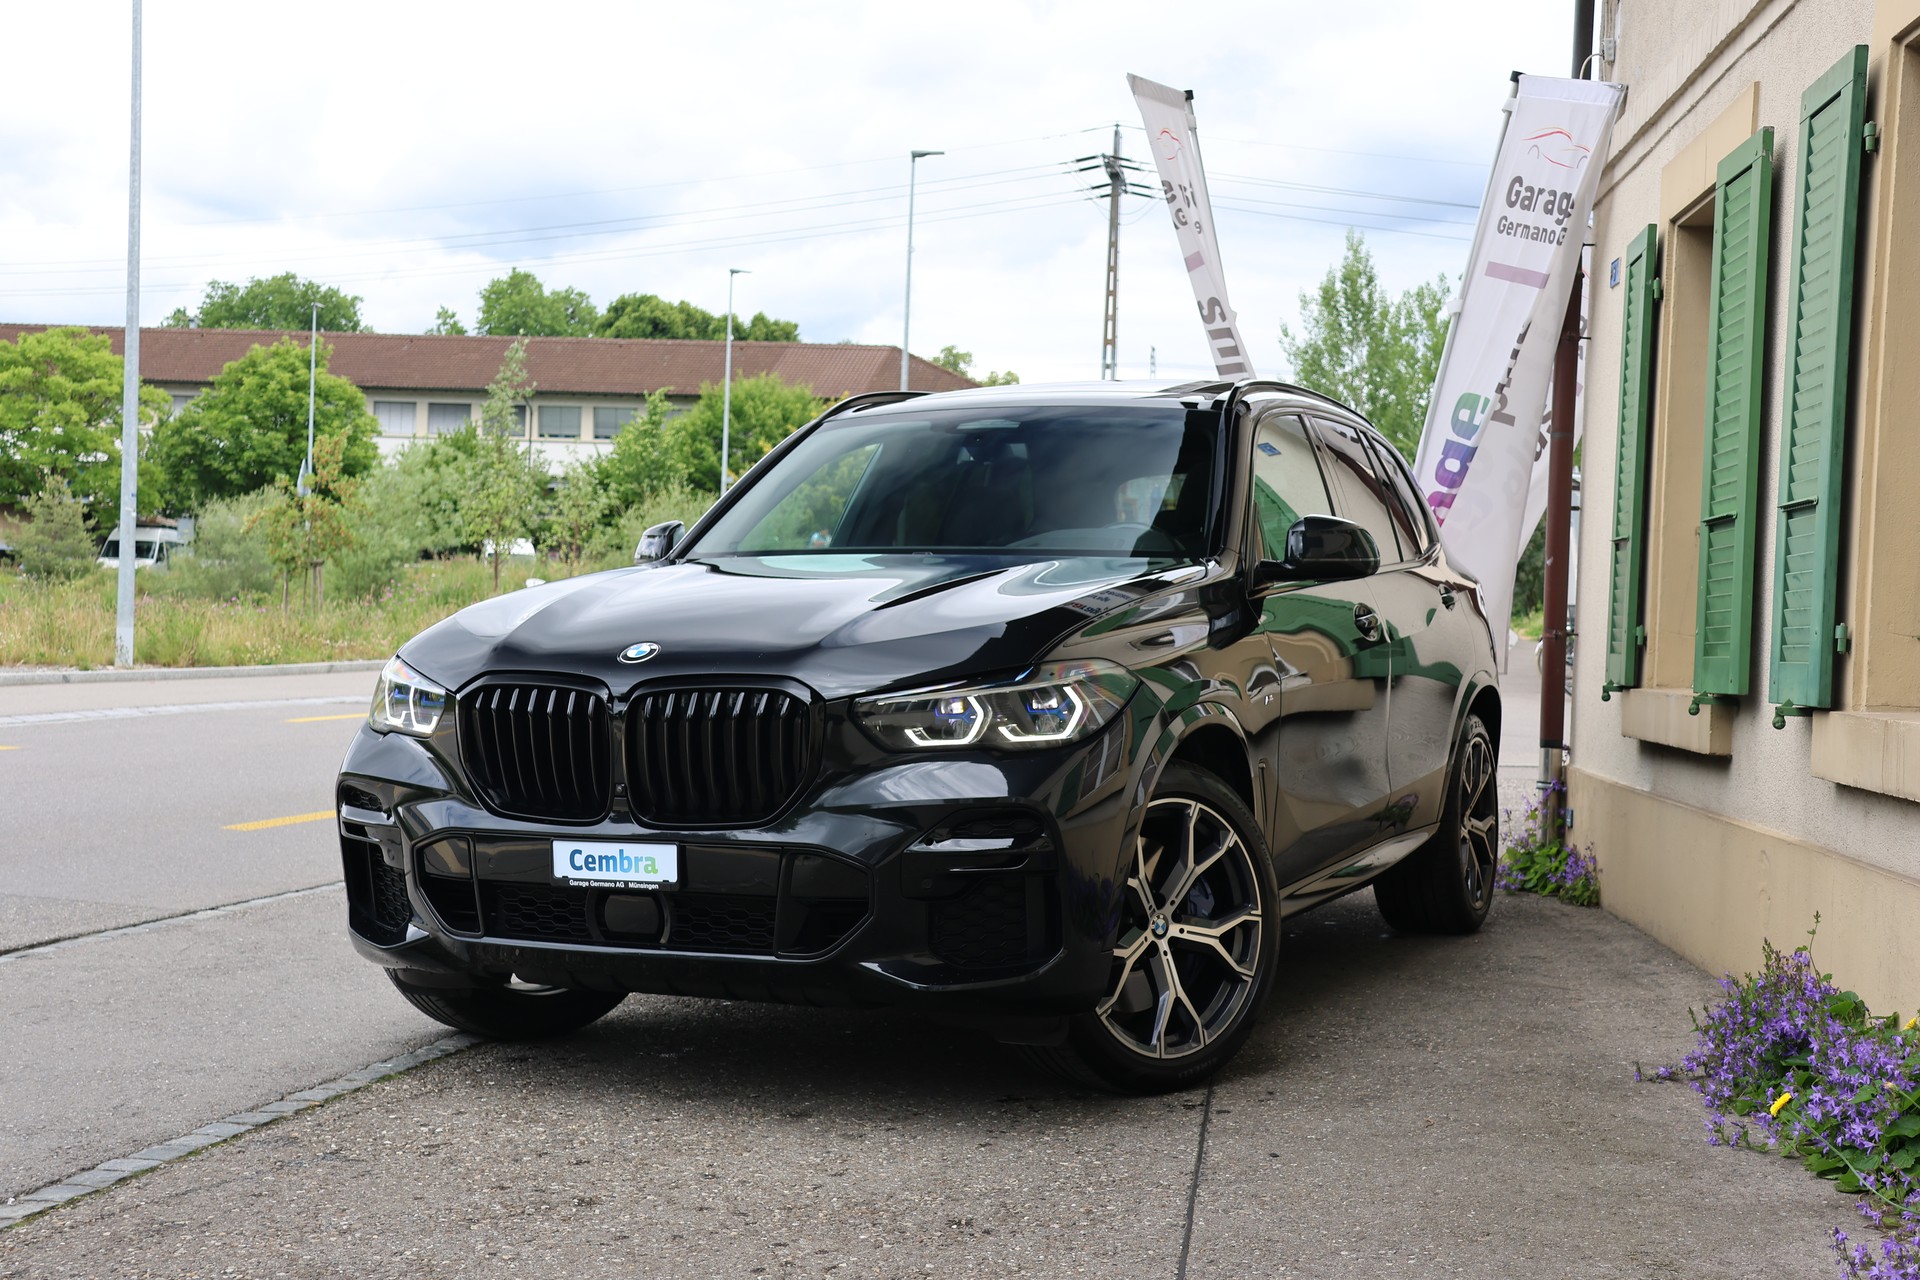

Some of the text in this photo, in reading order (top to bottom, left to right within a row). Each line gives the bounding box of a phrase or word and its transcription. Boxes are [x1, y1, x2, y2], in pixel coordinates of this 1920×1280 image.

[569, 849, 659, 875] Cembra
[569, 880, 589, 888] Garage
[590, 881, 615, 889] Germano
[628, 882, 659, 890] Münsingen
